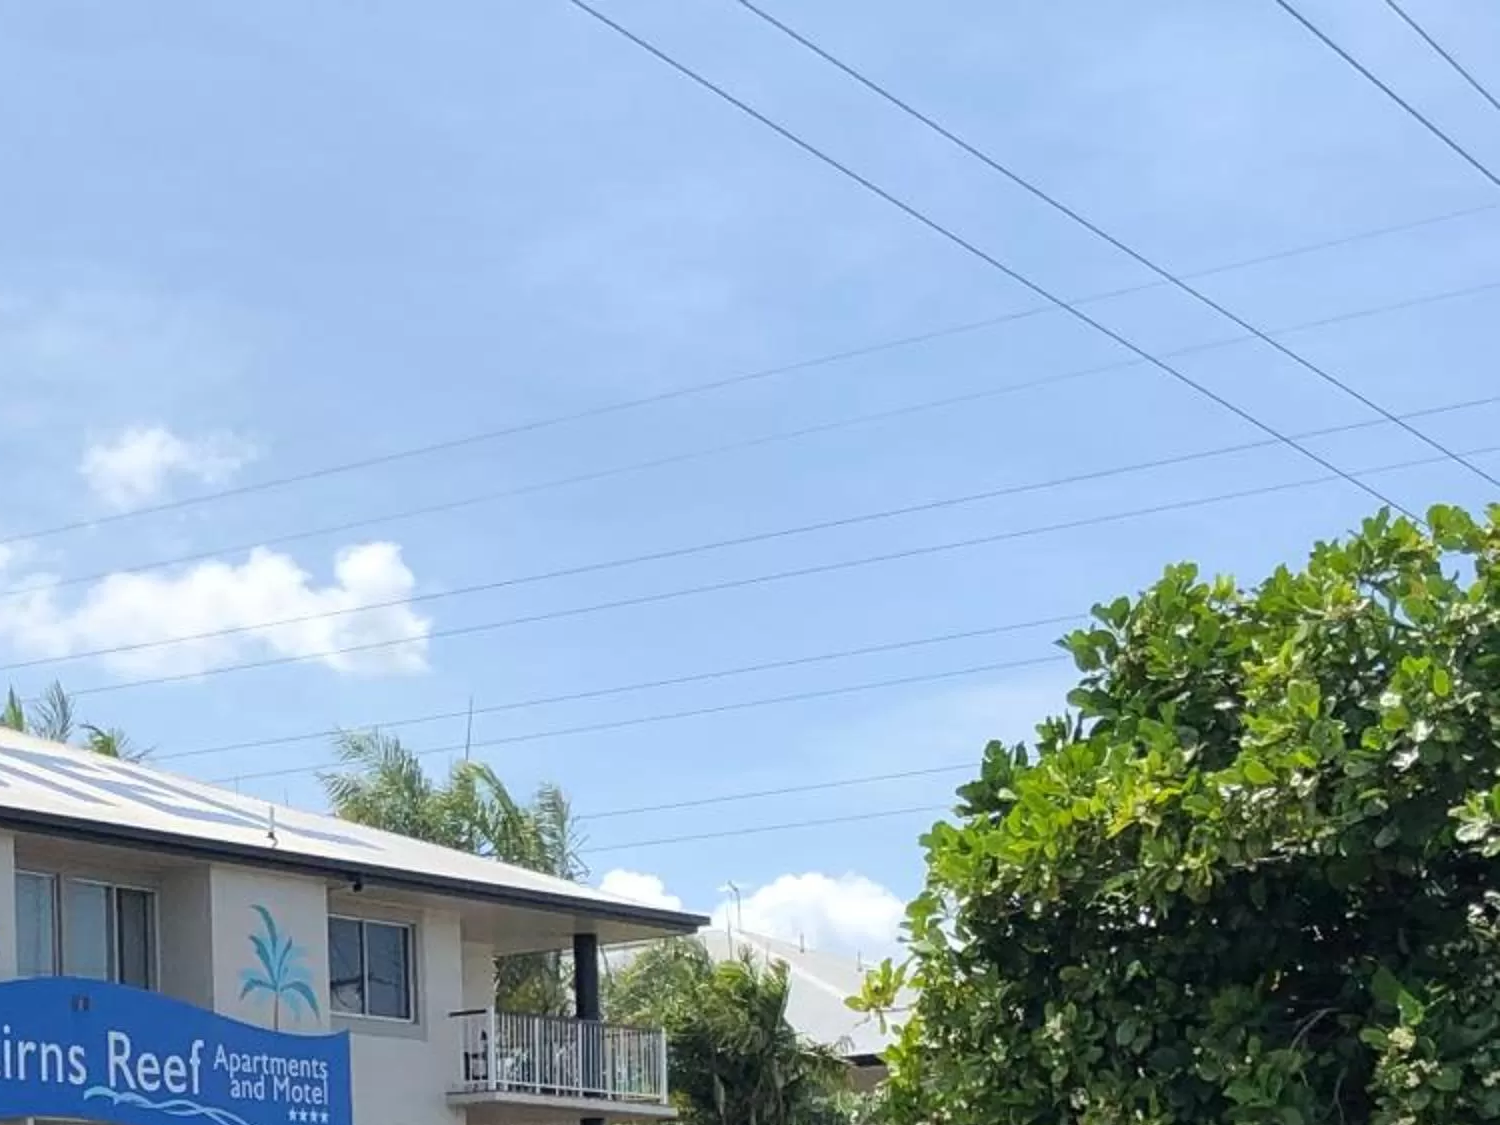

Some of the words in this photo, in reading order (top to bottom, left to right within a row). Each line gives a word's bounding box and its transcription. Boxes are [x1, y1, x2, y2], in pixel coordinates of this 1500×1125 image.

[107, 1030, 204, 1095] Reef
[213, 1044, 328, 1079] Apartments
[230, 1075, 265, 1101] and
[273, 1075, 329, 1105] Motel
